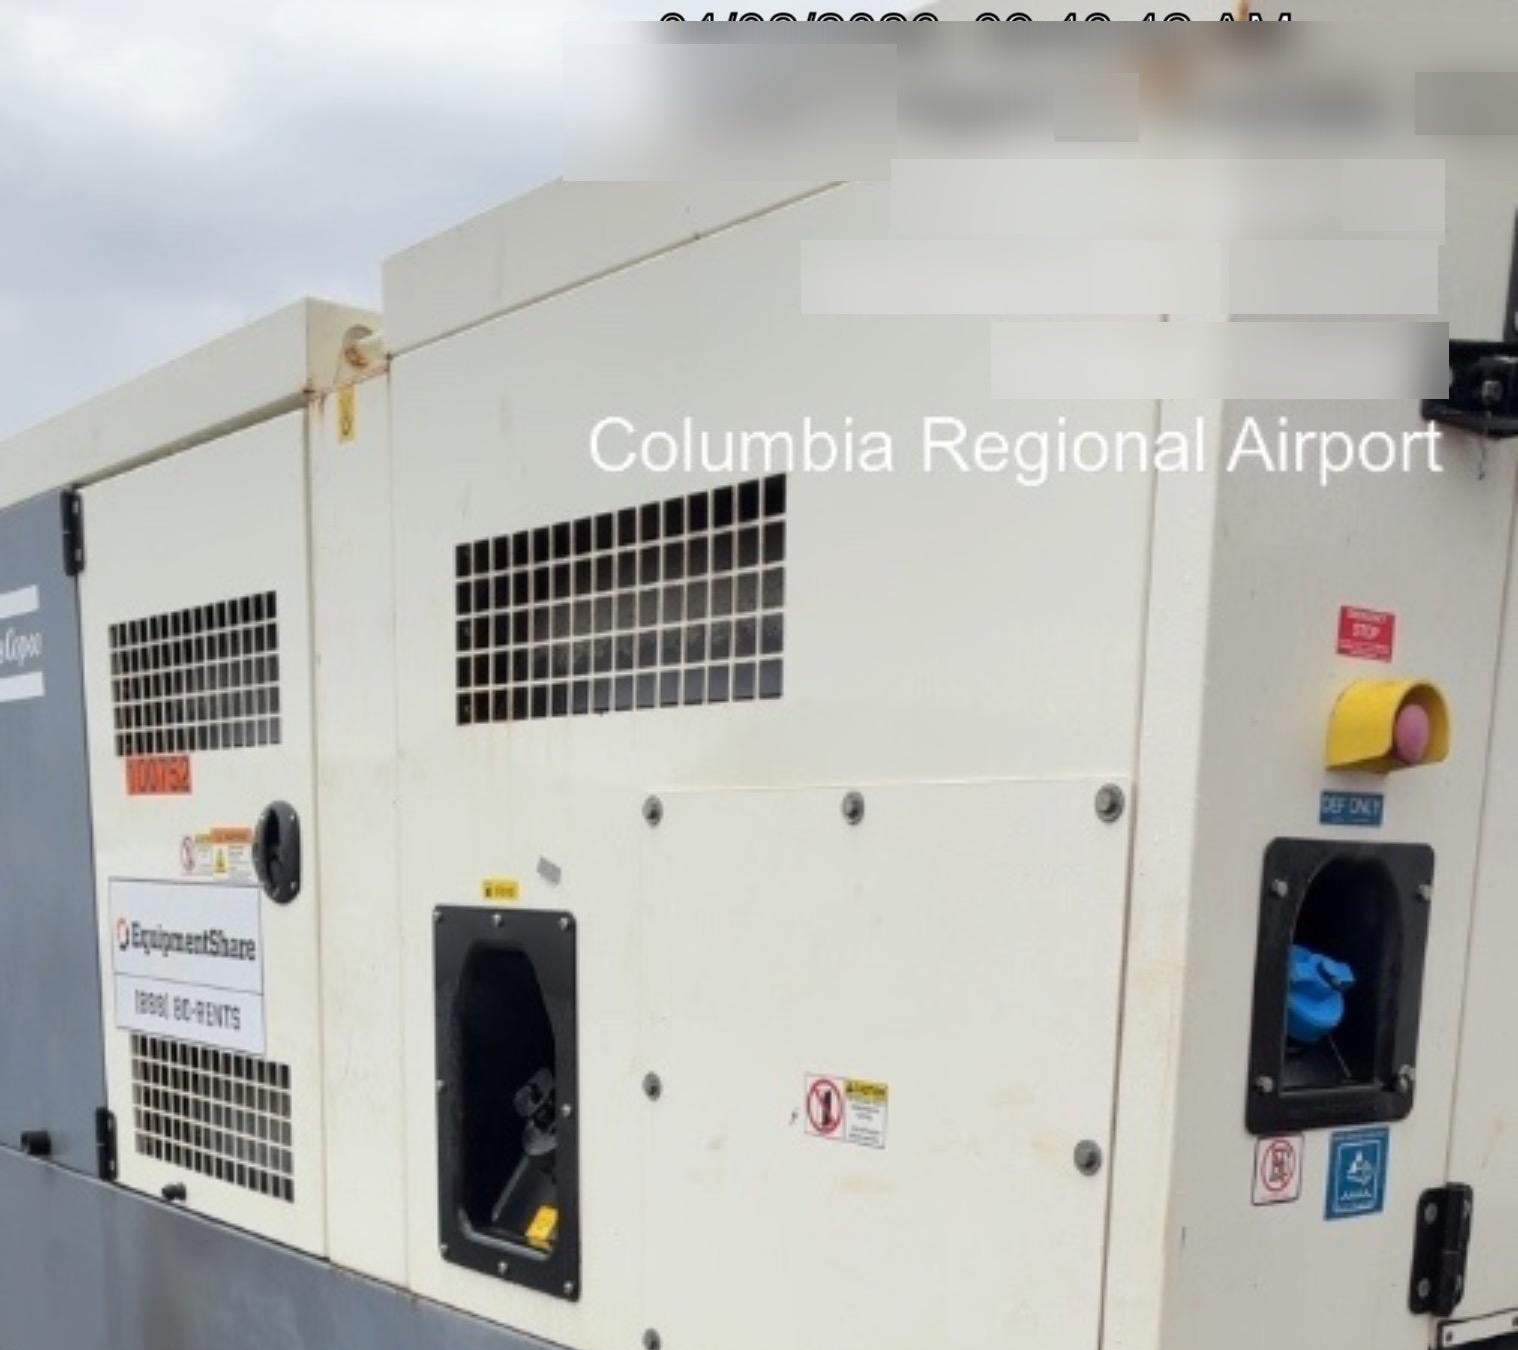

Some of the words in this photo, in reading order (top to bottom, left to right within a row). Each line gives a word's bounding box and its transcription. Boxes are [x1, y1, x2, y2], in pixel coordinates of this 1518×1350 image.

[1352, 623, 1380, 639] STOP
[1322, 794, 1345, 814] DEF
[1350, 797, 1381, 817] ONLY
[131, 920, 256, 961] EquipmentShare
[173, 996, 241, 1031] 80-RENTS
